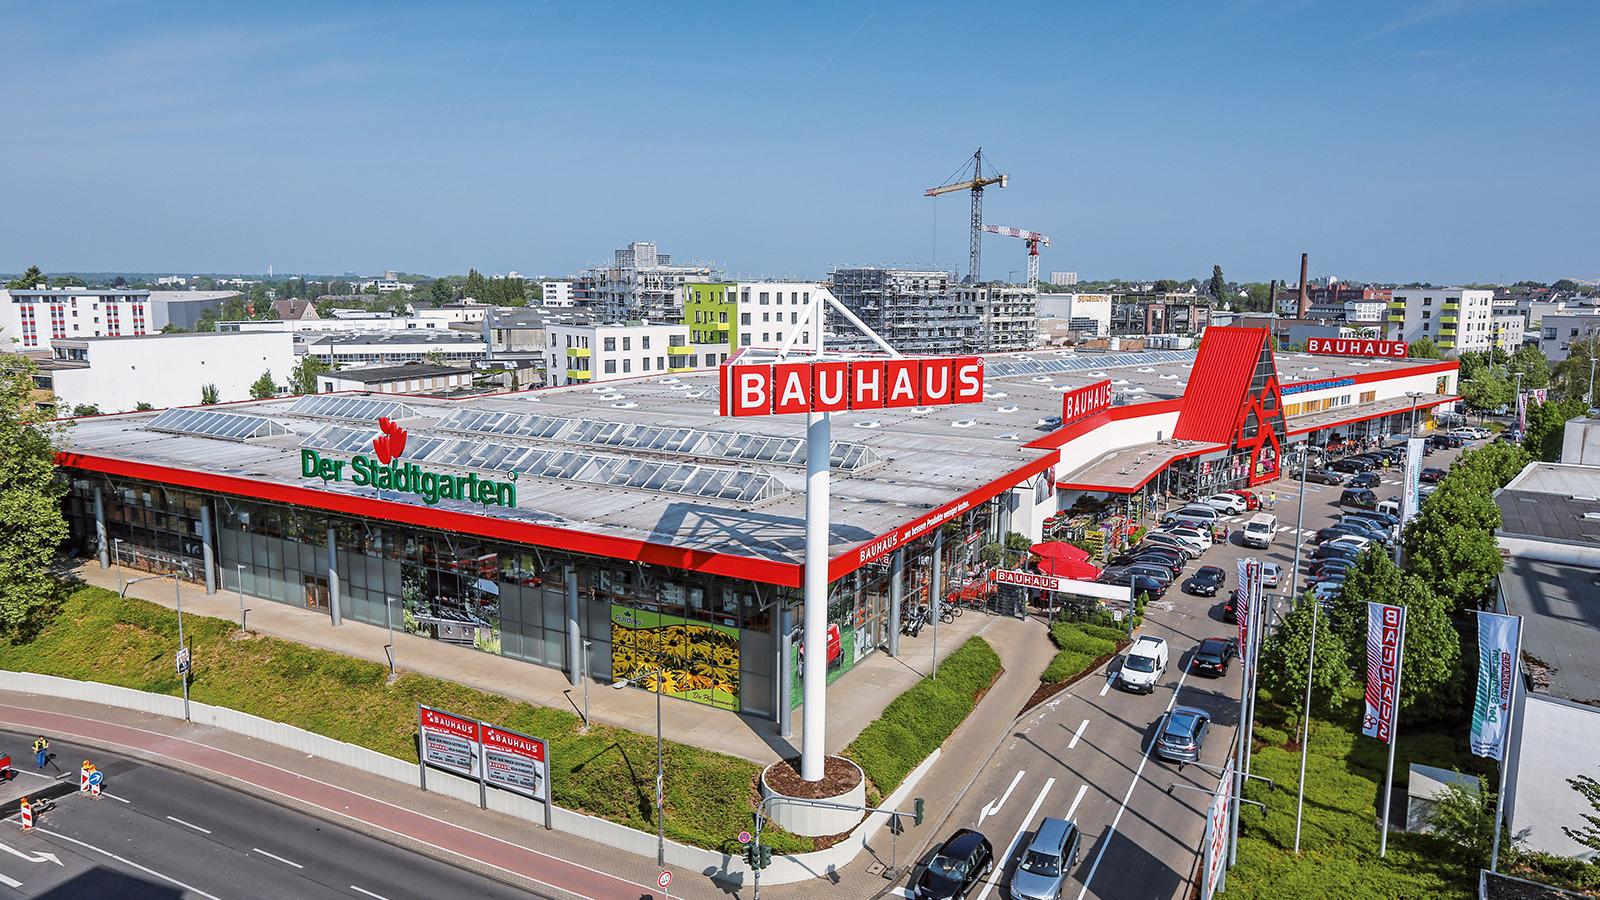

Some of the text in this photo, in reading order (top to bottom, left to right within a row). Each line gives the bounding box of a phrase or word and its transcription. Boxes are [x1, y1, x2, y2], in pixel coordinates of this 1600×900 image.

[1309, 339, 1404, 355] BAUHAUS
[741, 365, 980, 409] BAUHAUS
[1067, 384, 1111, 419] BAUHAUS
[301, 448, 517, 508] Der Stadtgarten
[860, 534, 898, 562] BAUHAUS
[999, 571, 1058, 588] BAUHAUS
[434, 716, 473, 734] BAUHAUS
[495, 734, 538, 753] BAUHAUS
